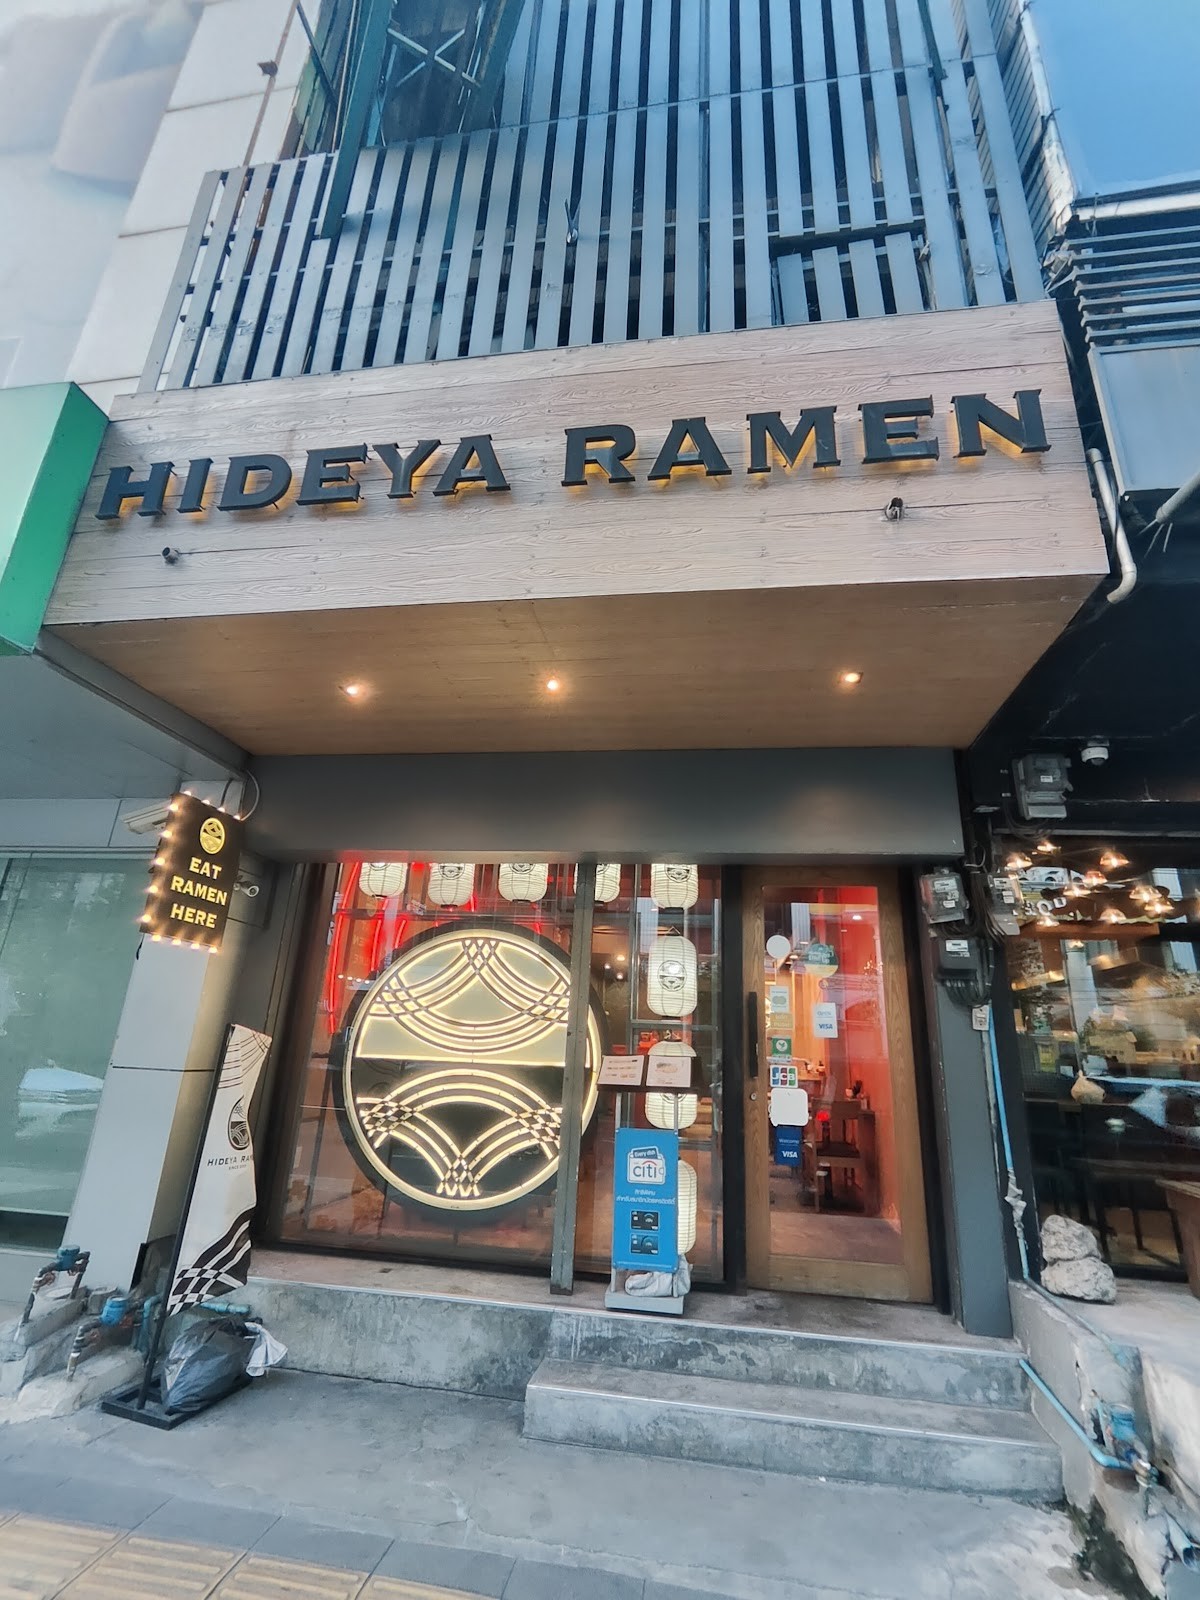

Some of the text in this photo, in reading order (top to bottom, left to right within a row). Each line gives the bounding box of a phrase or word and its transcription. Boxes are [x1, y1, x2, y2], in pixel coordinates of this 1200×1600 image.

[95, 389, 1052, 520] HIDEYA RAMEN
[189, 856, 222, 880] EAT
[170, 875, 228, 906] RAMEN
[170, 903, 218, 929] HERE
[772, 1069, 795, 1083] JCB
[207, 1156, 237, 1166] HIDEYA
[781, 1150, 798, 1158] VISA
[633, 1161, 657, 1178] citi
